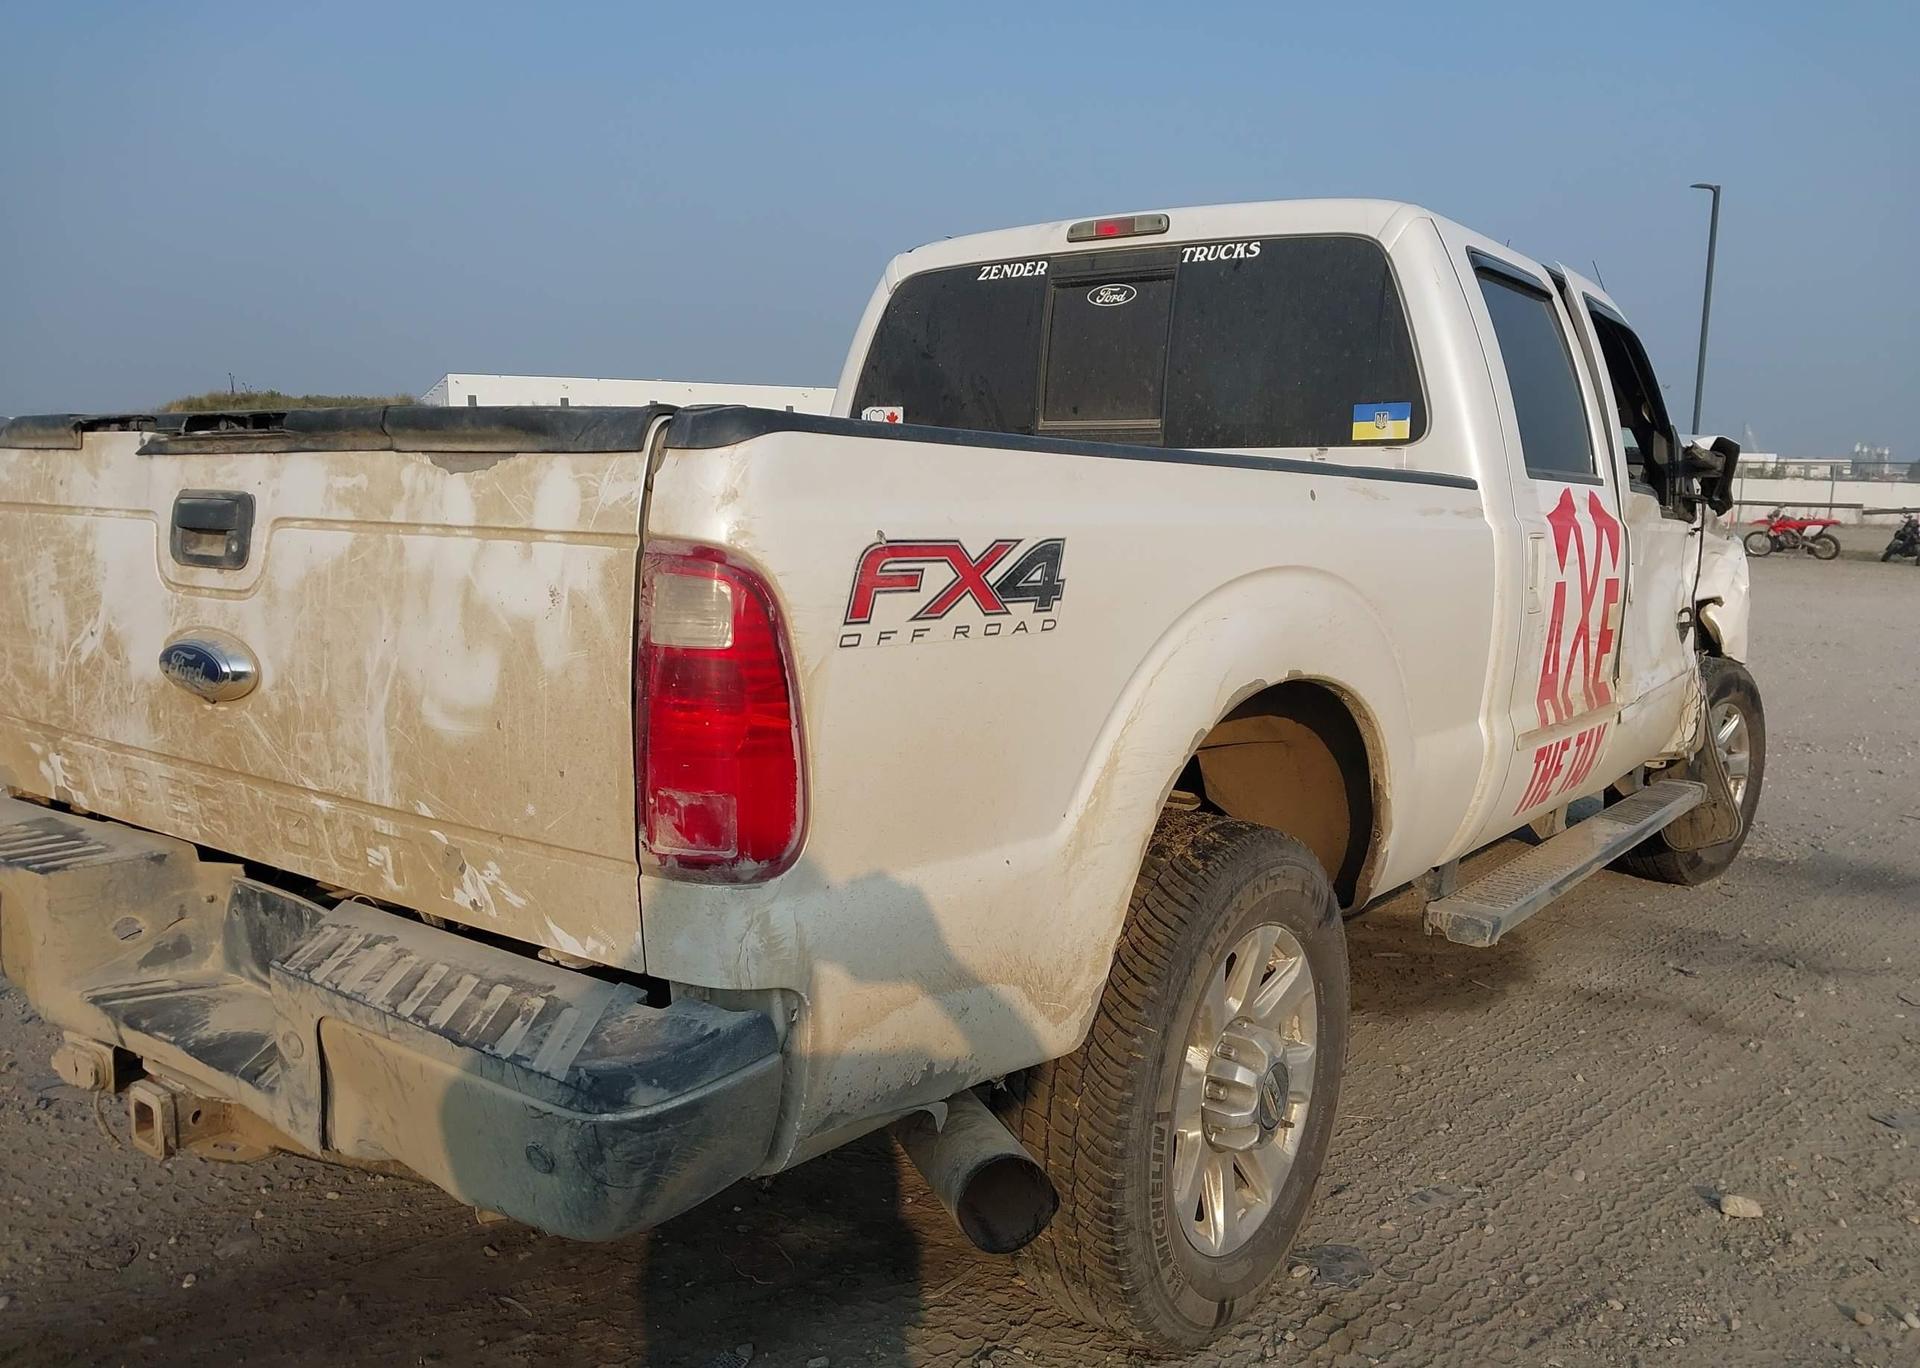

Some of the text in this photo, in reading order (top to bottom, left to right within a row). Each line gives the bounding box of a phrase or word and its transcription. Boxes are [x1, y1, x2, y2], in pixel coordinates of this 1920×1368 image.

[977, 242, 1261, 280] ZENDER TRUCKS
[1095, 286, 1127, 303] Ford
[843, 538, 1066, 626] FX4
[1536, 487, 1620, 728] AXE
[839, 618, 1057, 648] OFF ROAD
[169, 651, 207, 682] Ford
[1512, 722, 1608, 817] THE TAX
[1152, 1126, 1175, 1269] MICHELIN
